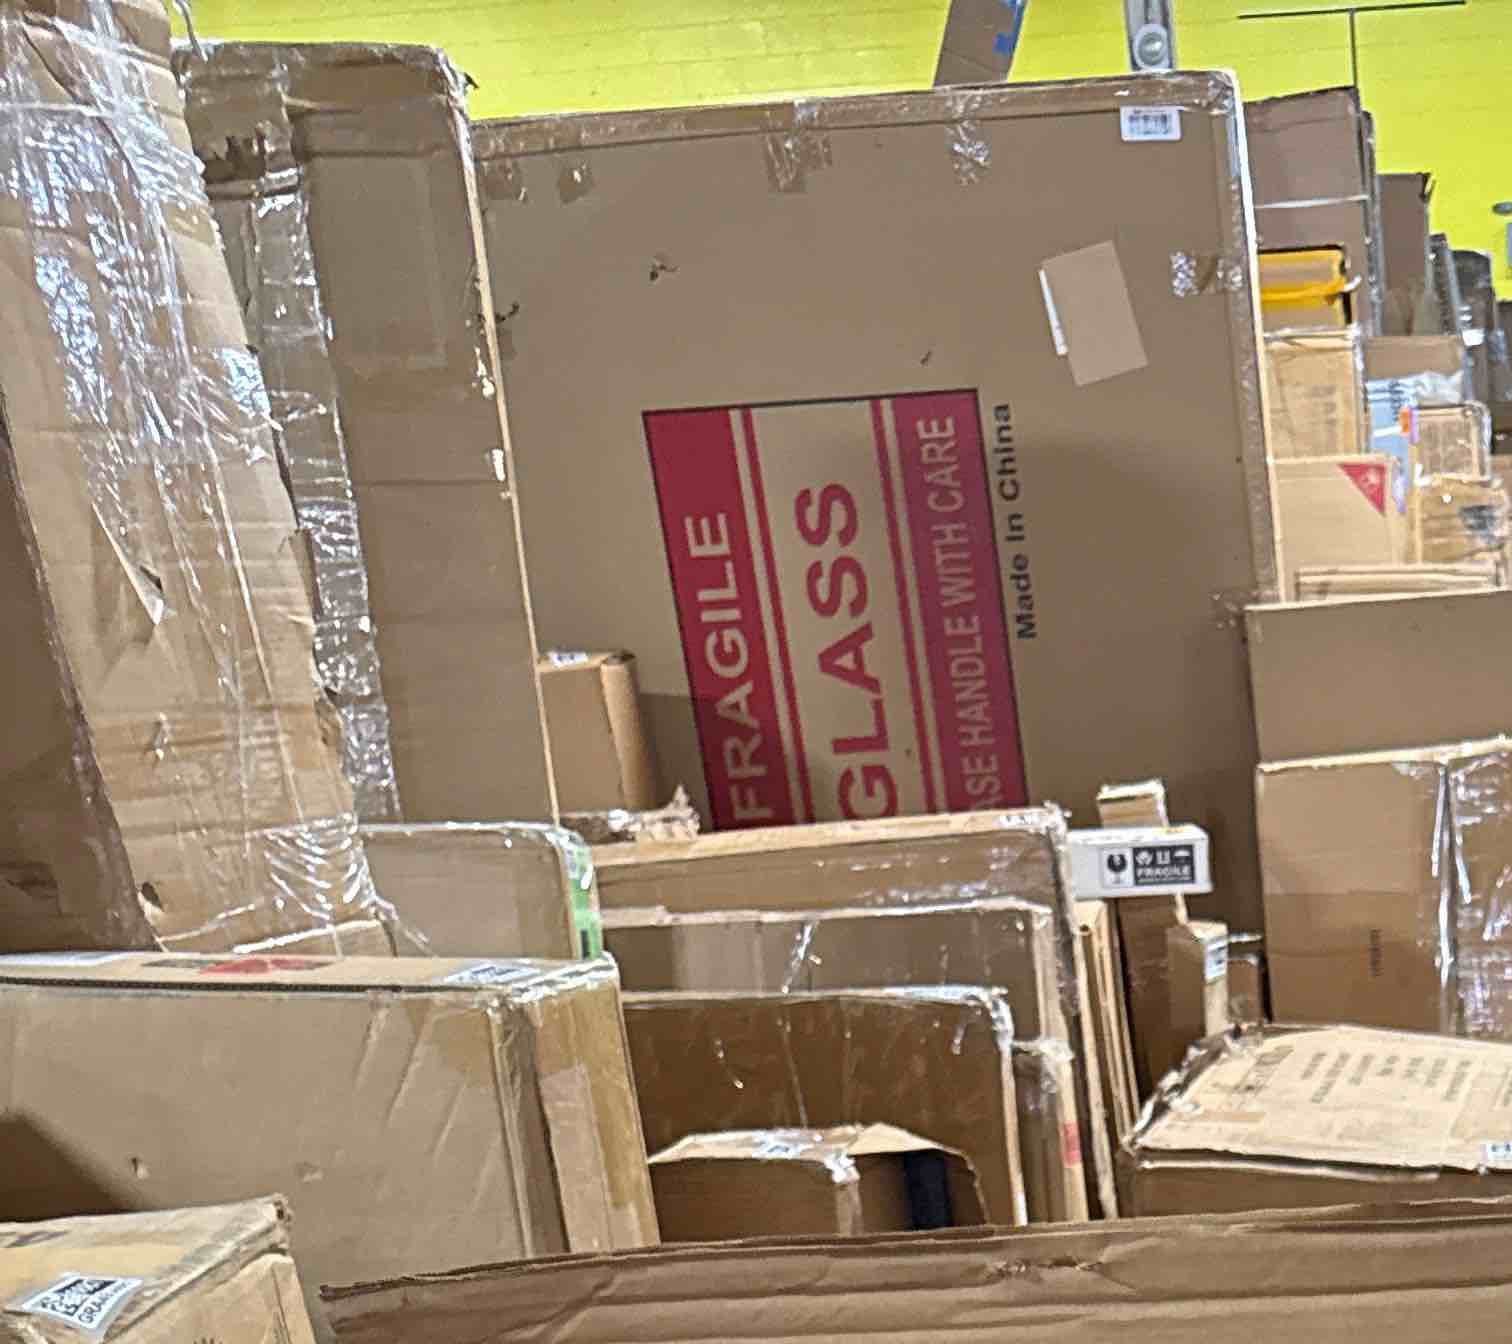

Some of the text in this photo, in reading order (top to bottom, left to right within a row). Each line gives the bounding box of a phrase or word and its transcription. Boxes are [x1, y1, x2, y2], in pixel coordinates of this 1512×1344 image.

[916, 415, 966, 513] CARE
[994, 403, 1021, 502] China
[928, 521, 977, 609] WITH
[1009, 552, 1037, 640] Made
[685, 512, 773, 821] FRAGILE
[794, 482, 898, 820] GLASS
[944, 614, 996, 747] HANDLE
